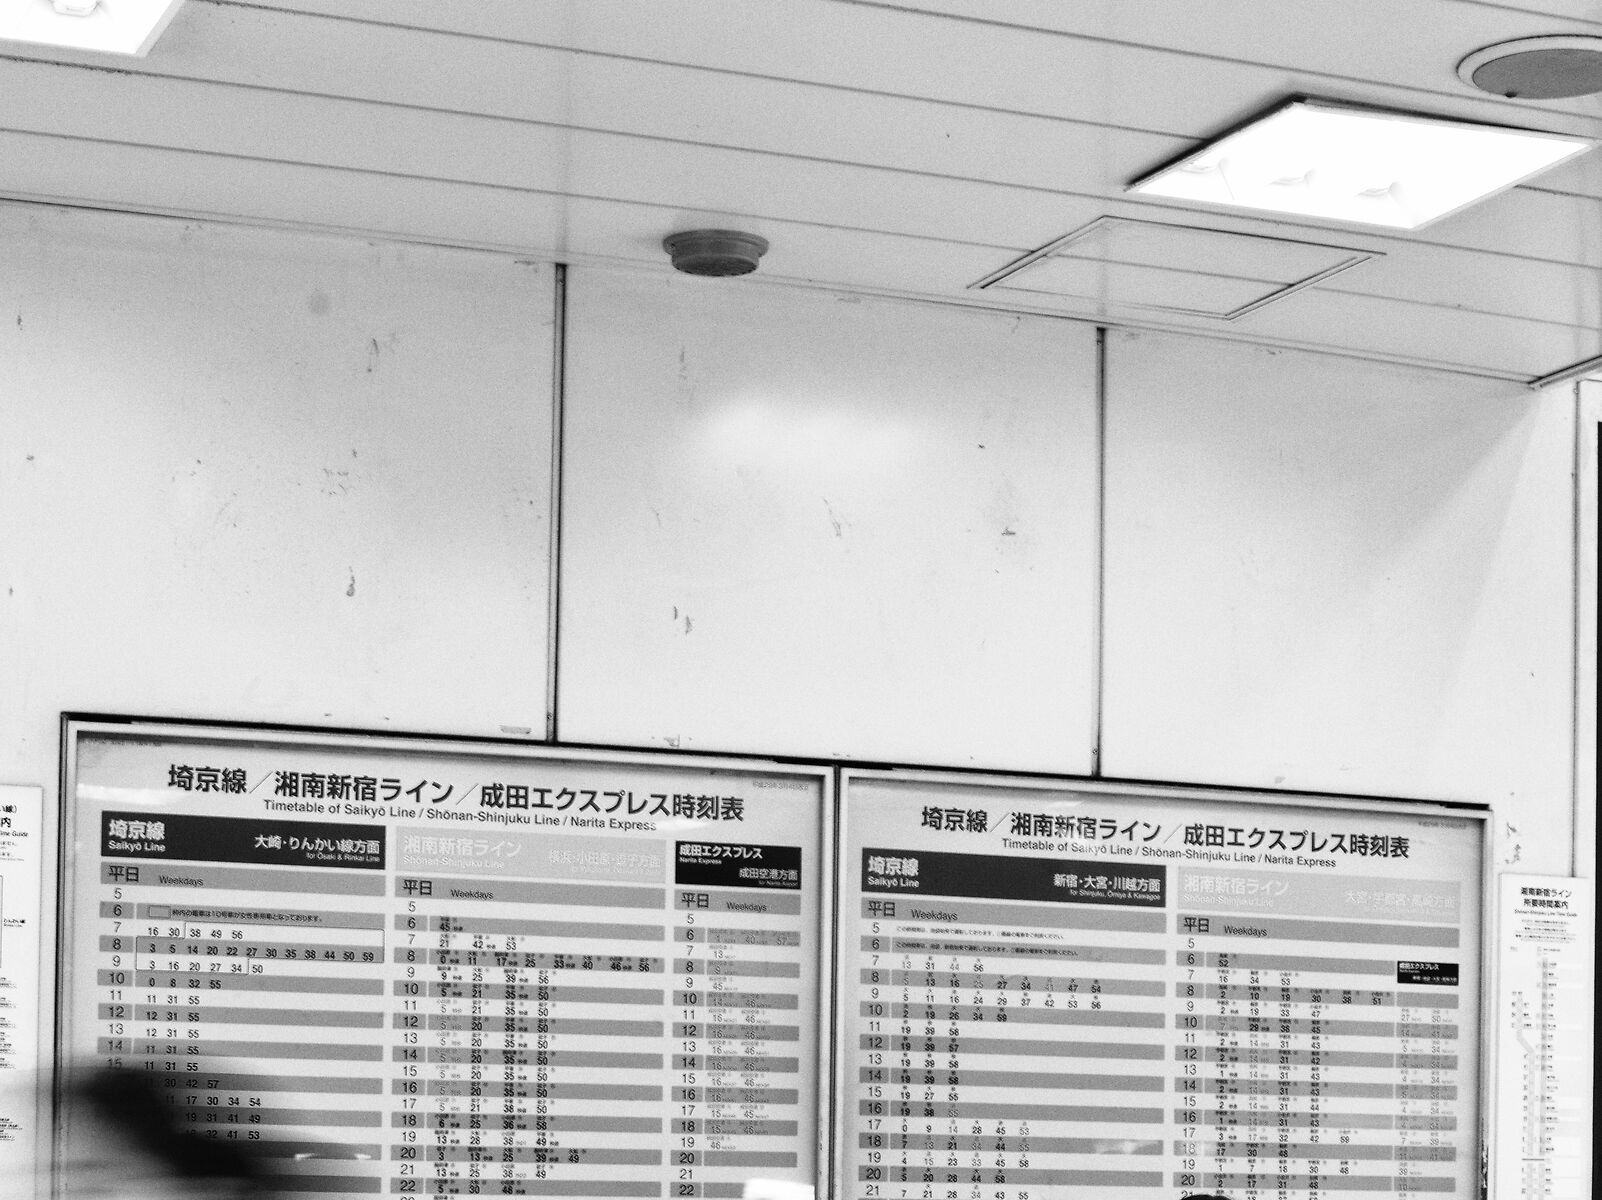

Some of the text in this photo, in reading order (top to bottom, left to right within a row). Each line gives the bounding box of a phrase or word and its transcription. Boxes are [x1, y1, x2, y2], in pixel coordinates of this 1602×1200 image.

[168, 764, 744, 822] 埼京線／湘南新宿ライン／成田エクスプレス時刻表
[264, 800, 656, 832] Timetable of Saikyō Line Shōnan-Shinjuku Line Narita Express
[108, 819, 165, 840] 埼京線
[922, 806, 1409, 858] 埼京線／湘南新宿ライン／成田エクスプレス時刻表
[144, 842, 166, 852] Line
[254, 834, 380, 854] 大崎・りんかい線方面
[404, 834, 521, 858] 湘南新宿ライン
[679, 844, 763, 860] 成田エクスプレス
[1002, 838, 1054, 851] Timetable
[1058, 842, 1068, 852] of
[1110, 844, 1132, 856] Line
[1142, 846, 1231, 862] Shōnan-Shinjuku
[1234, 852, 1256, 862] Line
[1264, 854, 1294, 865] Narita
[1297, 856, 1336, 868] Express
[306, 852, 314, 860] for
[739, 867, 798, 881] 成田空港方面
[868, 856, 919, 876] 埼京線
[108, 865, 203, 887] 平日 Weekdays
[900, 878, 920, 888] Line
[1054, 873, 1160, 892] 新宿・大宮・川越方面
[1184, 873, 1290, 896] 湘南新宿ライン
[115, 889, 122, 899] 5
[403, 880, 494, 900] 平日 Weekdays
[114, 906, 121, 916] 6
[681, 892, 767, 913] 平日 Weekdays
[868, 900, 958, 922] 平日 Weekdays
[114, 923, 242, 939] 7 16 30 38 49 56
[1184, 917, 1267, 938] 平日 Weekdays
[113, 939, 121, 949] 8
[170, 944, 175, 953] 5
[188, 945, 198, 953] 14
[207, 946, 218, 955] 20
[227, 947, 238, 955] 22
[247, 947, 257, 956] 27
[266, 949, 277, 957] 30
[286, 949, 296, 958] 35
[305, 950, 315, 959] 38
[325, 951, 335, 959] 44
[344, 952, 354, 960] 50
[363, 953, 373, 961] 59
[113, 956, 120, 966] 9
[169, 962, 179, 971] 16
[189, 963, 200, 972] 20
[211, 964, 221, 972] 27
[232, 964, 242, 972] 34
[253, 965, 263, 973] 50
[109, 974, 221, 989] 10 0 8 32 55
[1187, 970, 1291, 986] 7 16 34 53
[111, 991, 121, 1000] 11
[866, 1169, 881, 1179] 20
[866, 1185, 879, 1196] 21
[923, 1190, 932, 1199] 21
[971, 1191, 981, 1200] 34
[995, 1192, 1005, 1200] 43
[1019, 1192, 1029, 1200] 55
